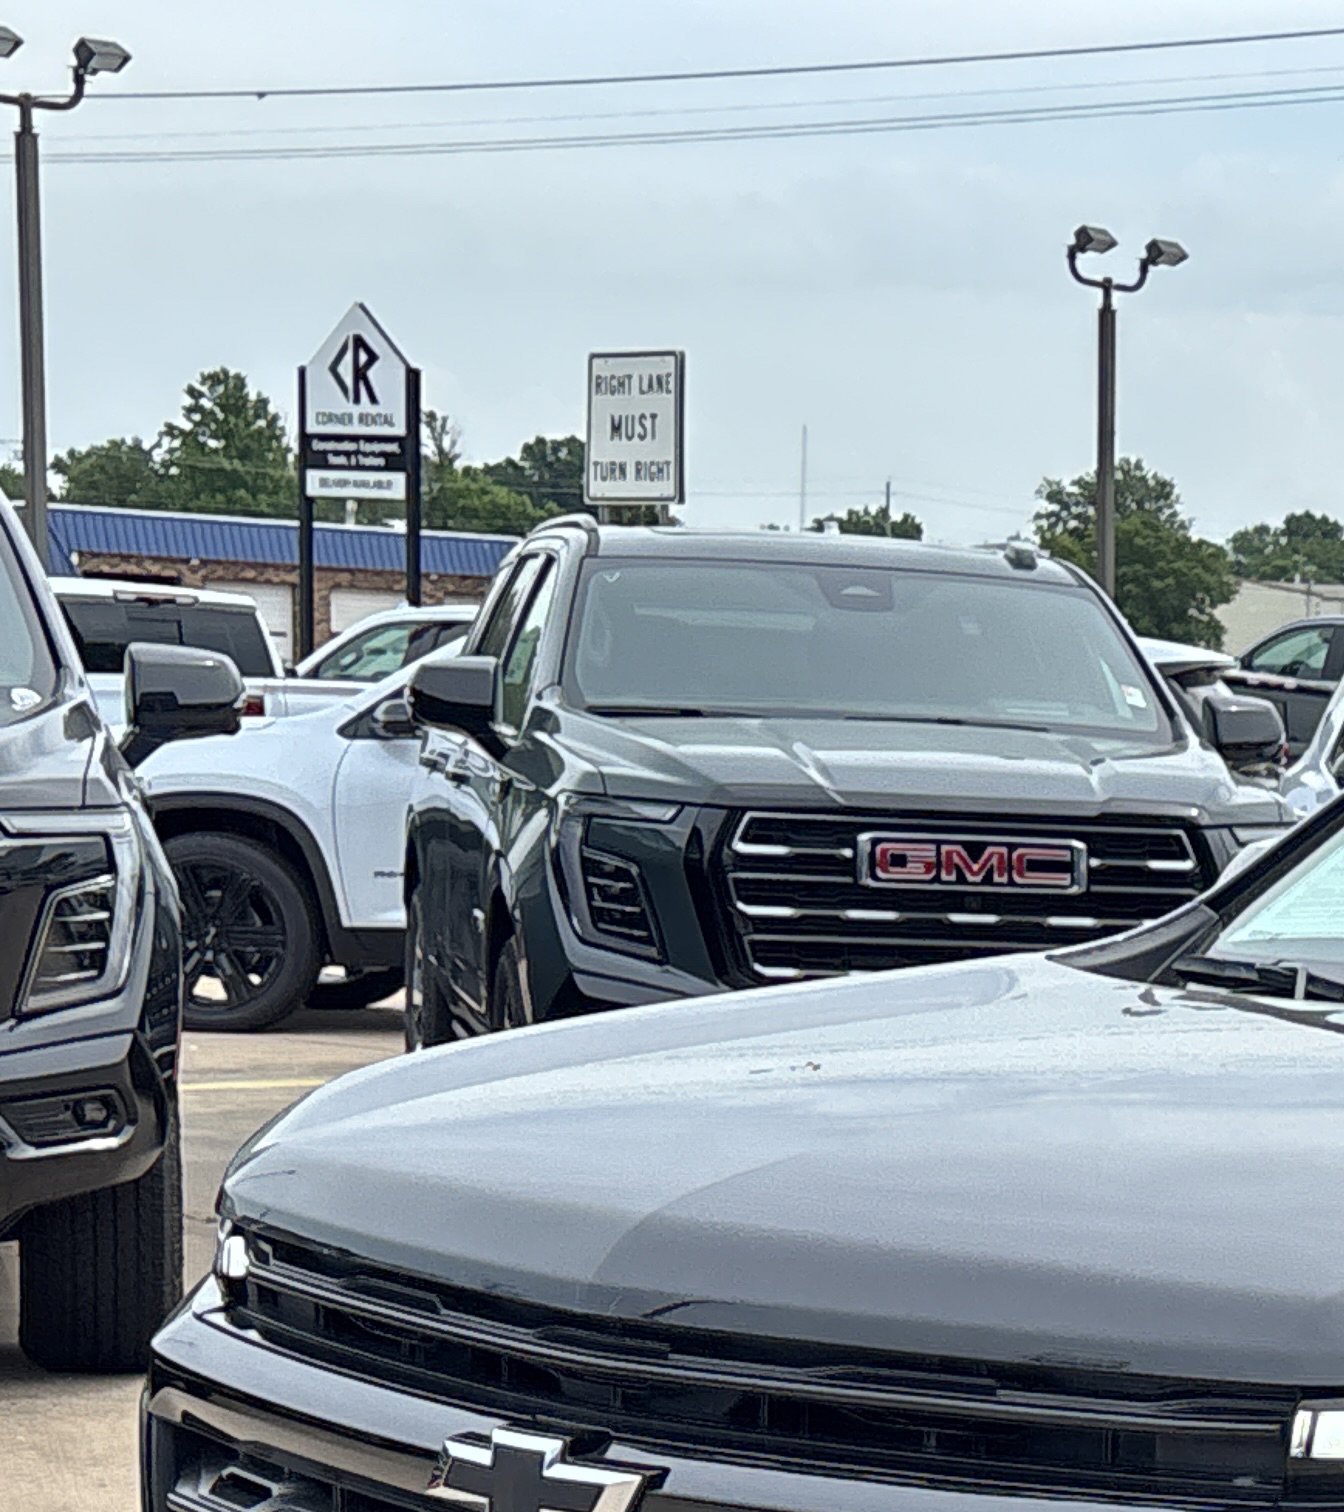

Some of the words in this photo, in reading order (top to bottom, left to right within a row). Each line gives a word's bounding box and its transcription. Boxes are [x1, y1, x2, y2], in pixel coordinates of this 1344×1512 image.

[594, 373, 633, 397] RIGHT
[638, 372, 673, 396] LANE
[315, 411, 354, 427] CORNER
[358, 412, 396, 428] RENTAL
[609, 412, 659, 442] MUST
[592, 460, 628, 483] TURN
[634, 460, 672, 483] RIGHT
[875, 842, 1072, 886] GMC
